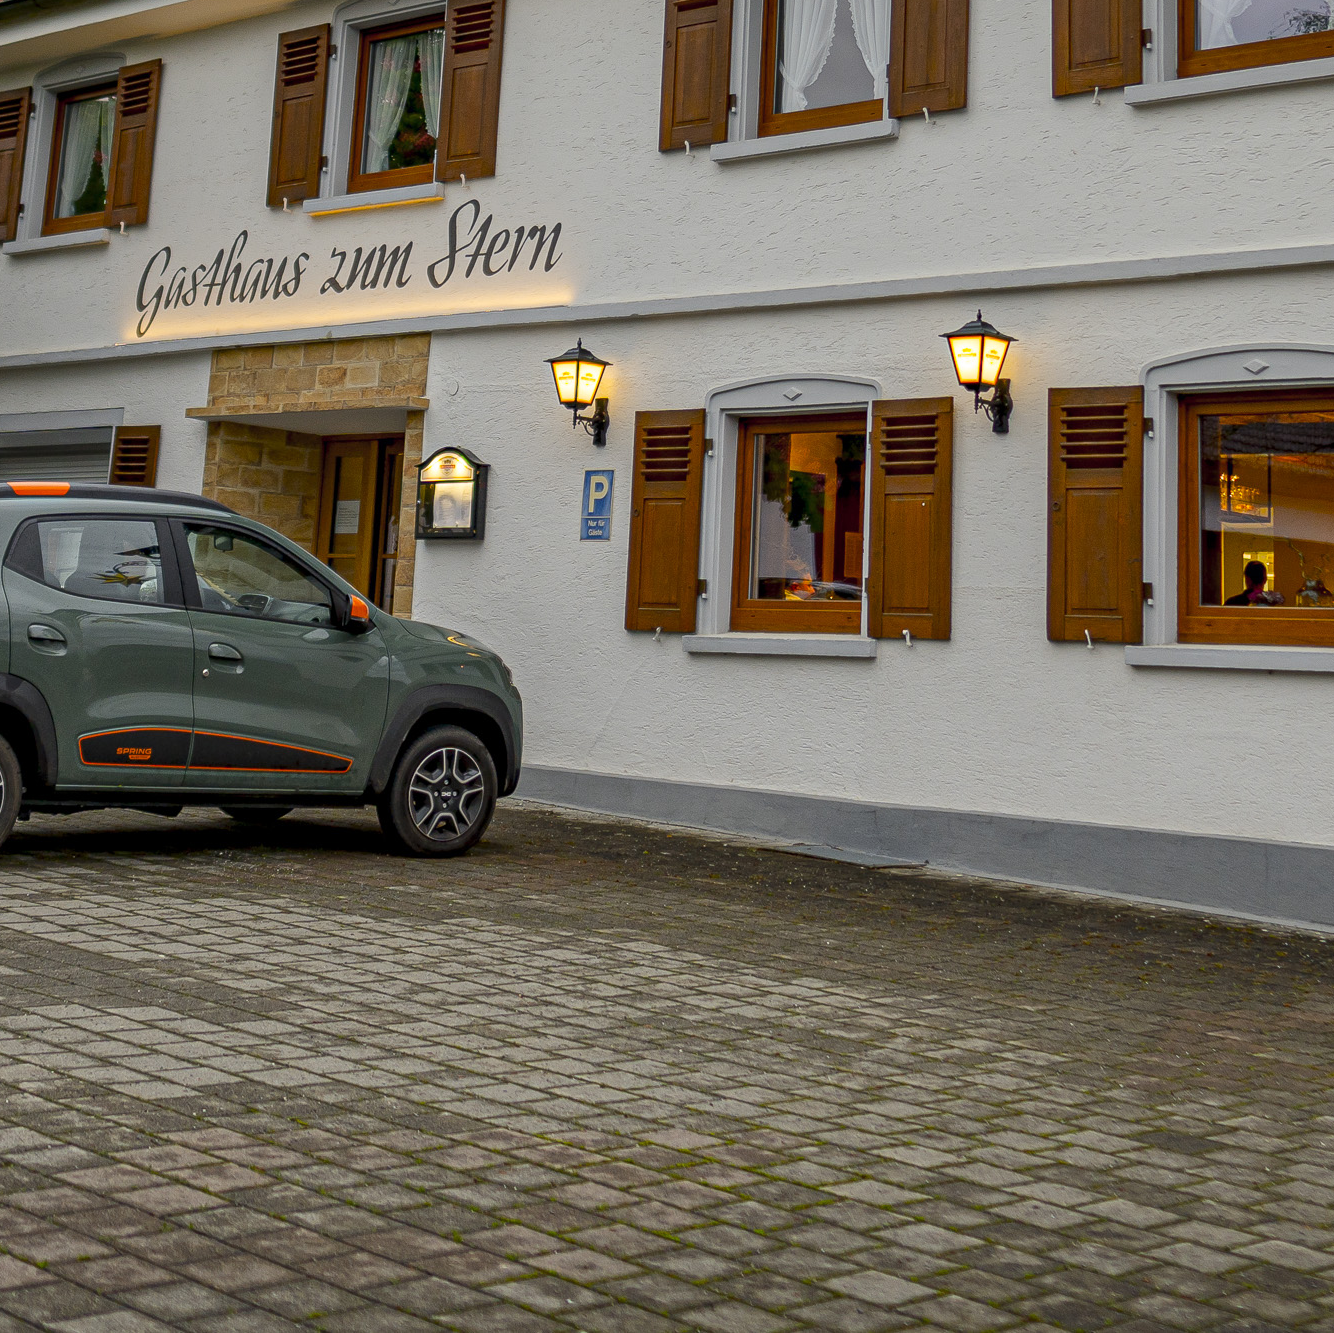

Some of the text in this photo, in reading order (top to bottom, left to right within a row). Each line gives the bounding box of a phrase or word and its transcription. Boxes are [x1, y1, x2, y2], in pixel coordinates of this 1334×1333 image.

[136, 199, 564, 338] Gasthaus zum Stern
[588, 475, 609, 513] P
[116, 747, 152, 755] SPRING
